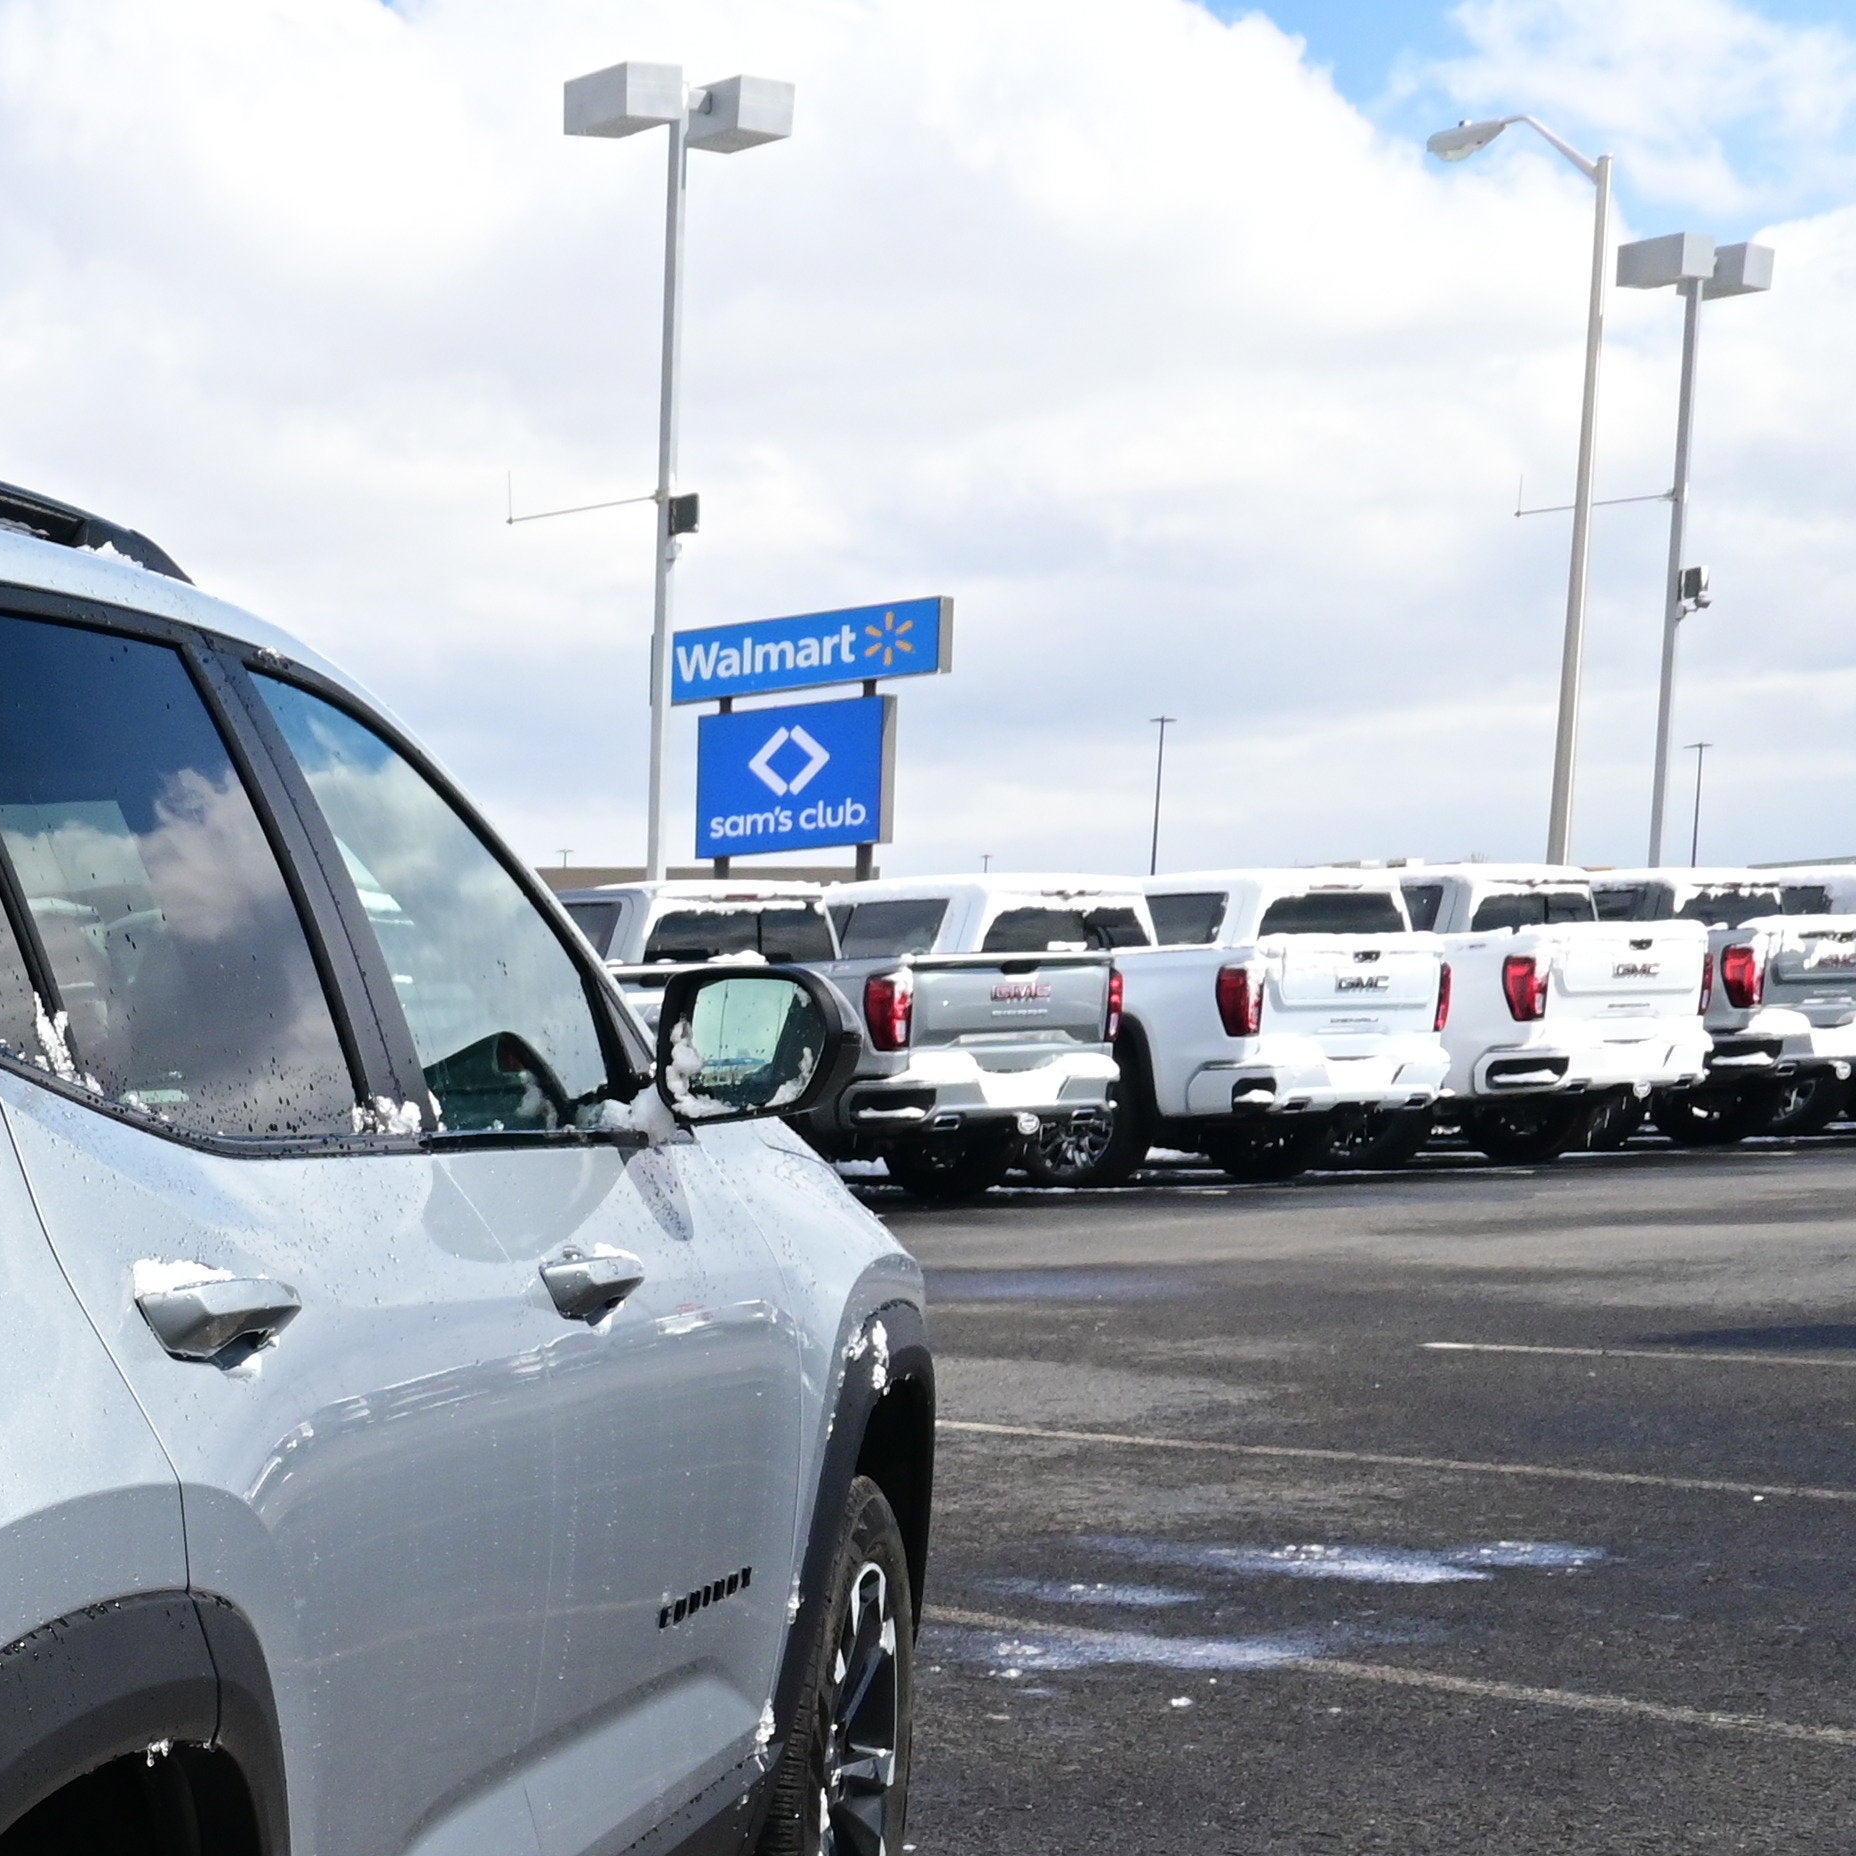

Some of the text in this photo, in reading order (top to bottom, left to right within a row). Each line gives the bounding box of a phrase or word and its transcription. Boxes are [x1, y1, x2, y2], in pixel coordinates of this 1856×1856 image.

[676, 625, 856, 683] Walmart
[710, 797, 866, 839] sam's club
[991, 983, 1050, 1001] GMC
[1335, 976, 1389, 992] GMC
